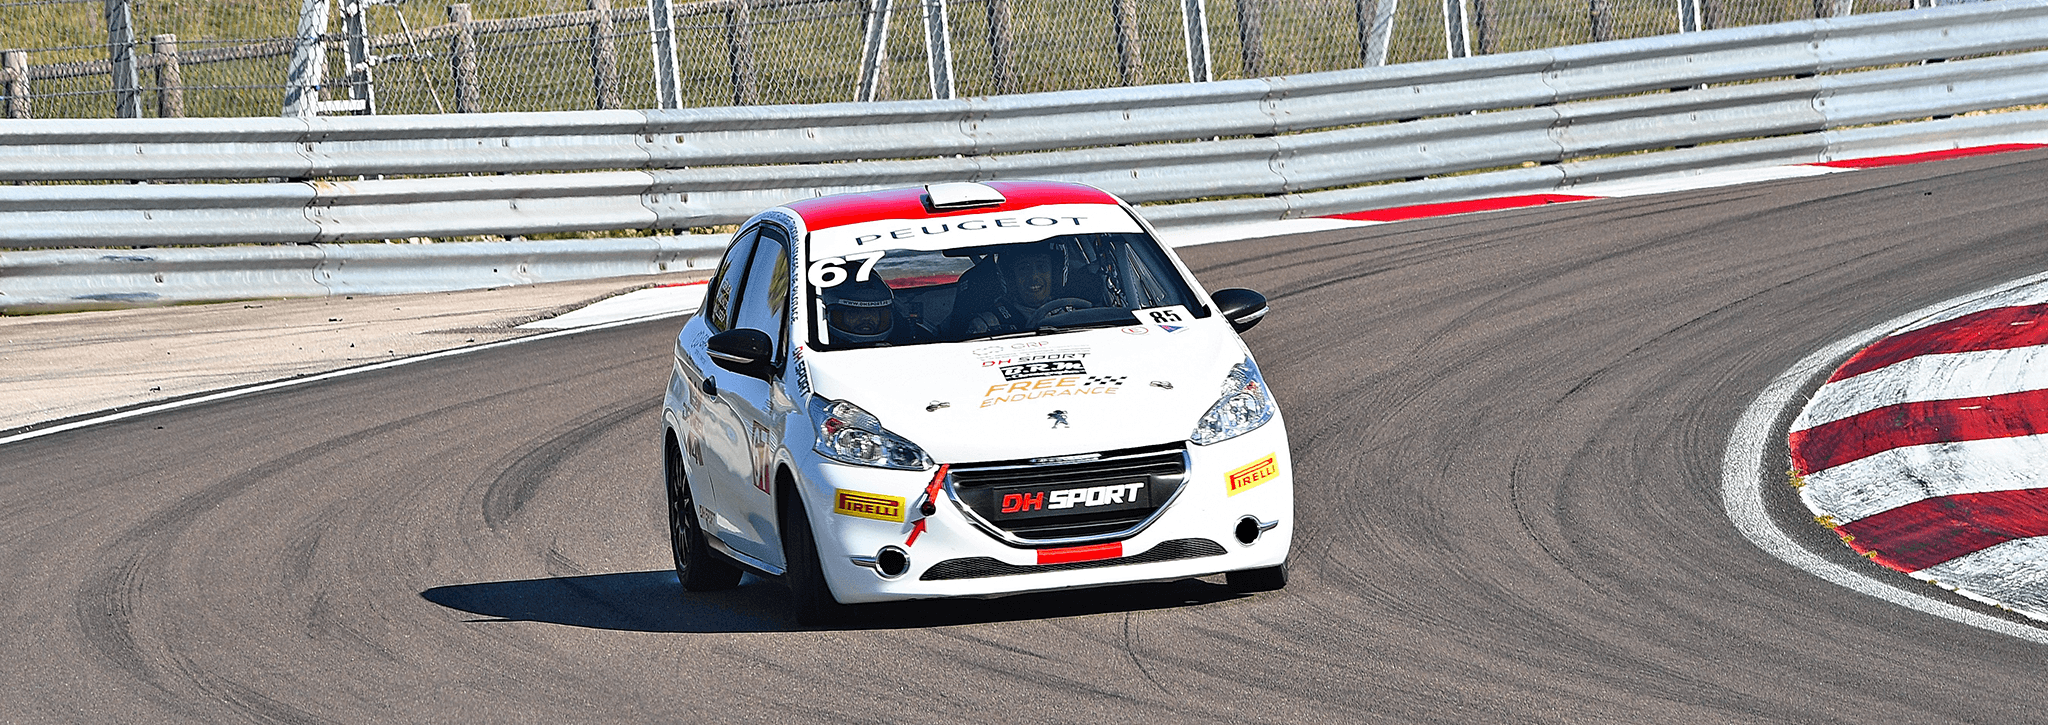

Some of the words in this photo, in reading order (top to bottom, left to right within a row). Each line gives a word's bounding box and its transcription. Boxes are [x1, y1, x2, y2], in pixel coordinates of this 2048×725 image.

[855, 216, 1088, 247] PEUGEOT
[807, 249, 887, 289] 67
[1149, 309, 1182, 323] 85
[793, 345, 804, 364] DH
[982, 358, 1012, 367] DH
[1017, 352, 1091, 363] SPORT
[795, 360, 811, 398] SPORT
[985, 377, 1080, 397] FREE
[979, 387, 1119, 408] ENDURANCE
[1229, 456, 1276, 488] PIRELLI
[838, 494, 899, 517] PIRELLI
[1001, 491, 1044, 514] DH
[1047, 482, 1145, 510] SPORT
